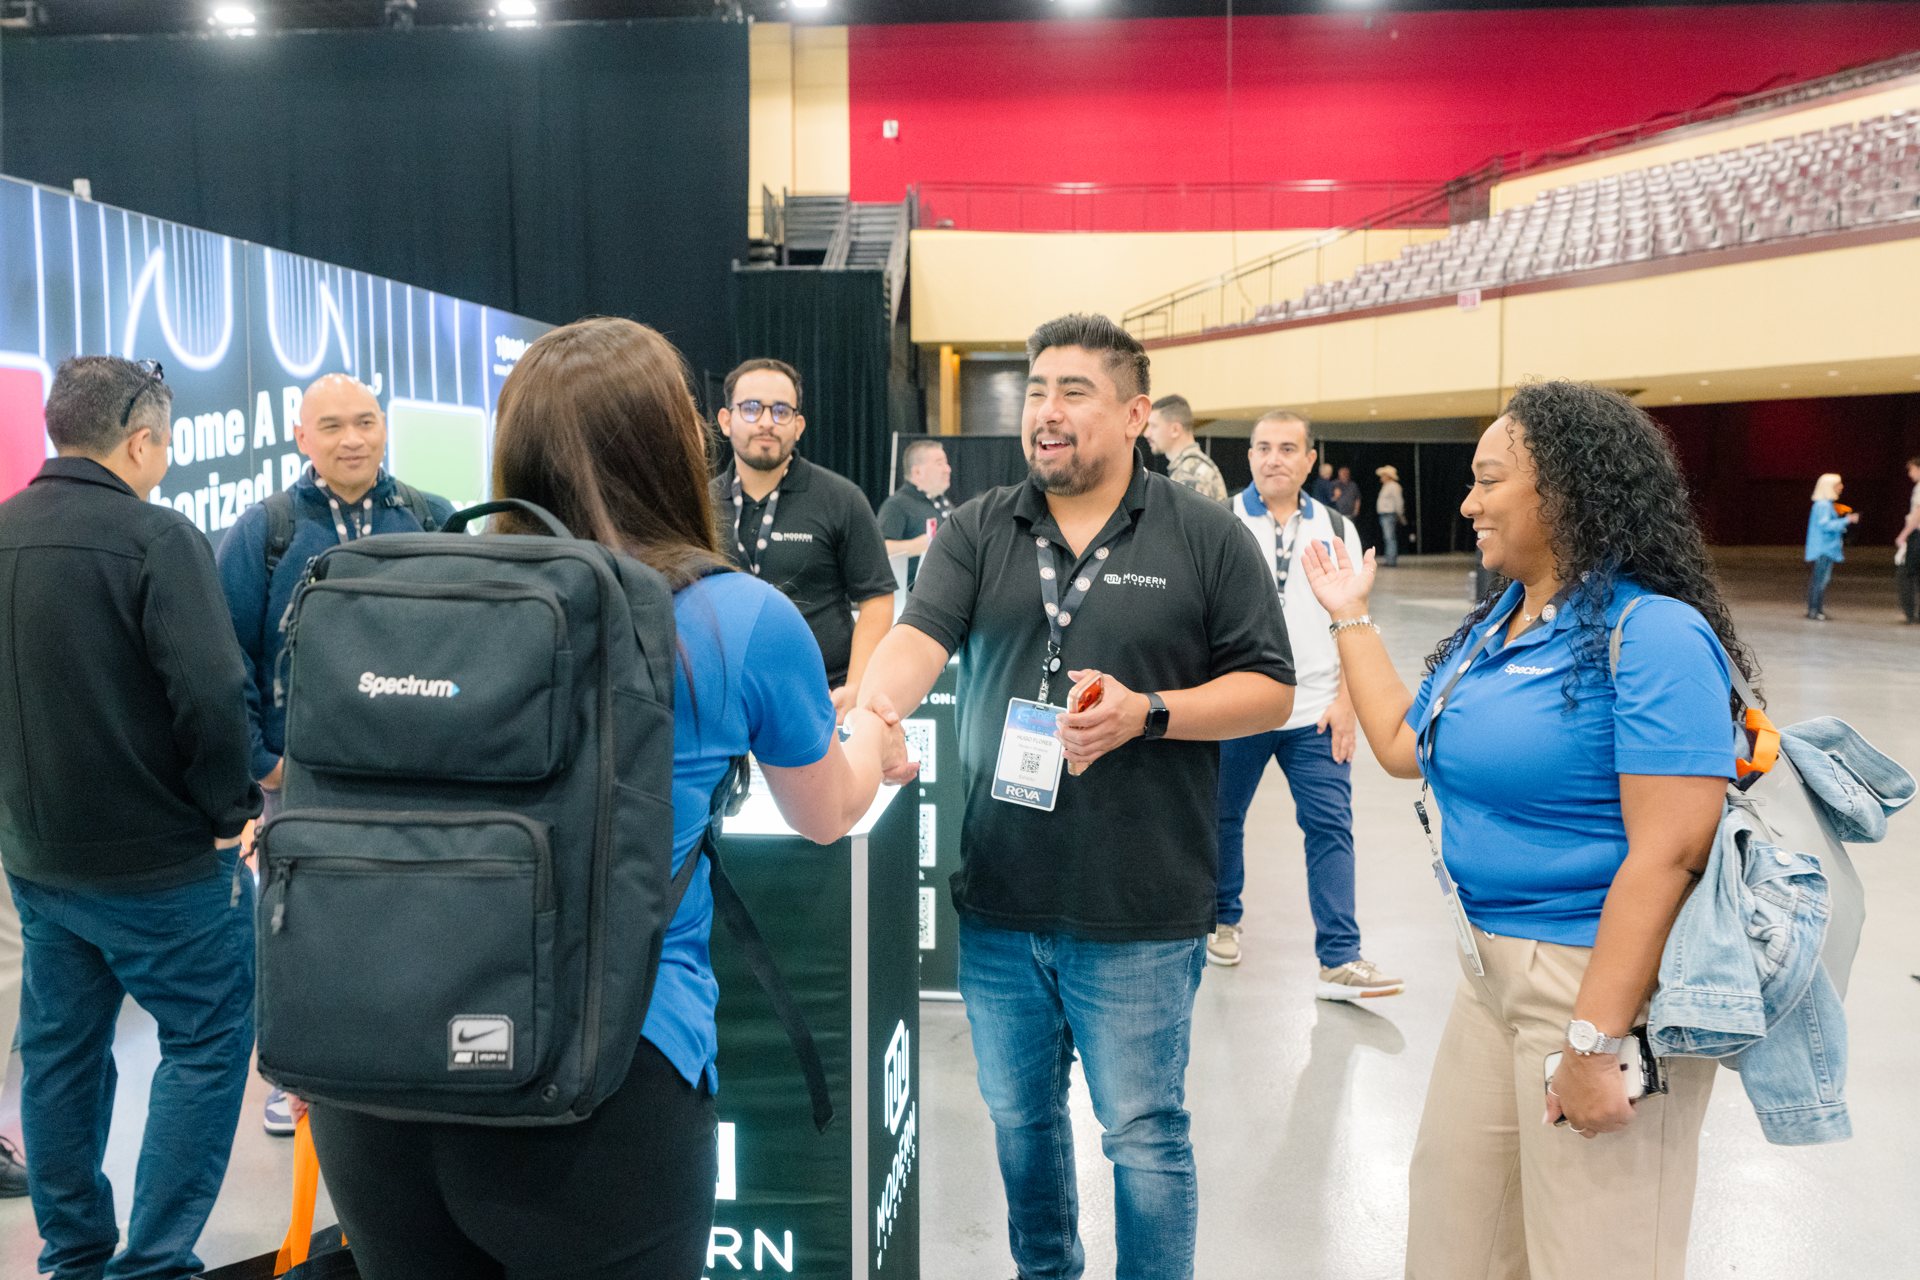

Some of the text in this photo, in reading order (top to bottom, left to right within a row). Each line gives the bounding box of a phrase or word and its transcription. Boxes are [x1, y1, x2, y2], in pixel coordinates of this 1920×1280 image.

[167, 409, 246, 467] ome
[253, 390, 276, 449] A
[1123, 572, 1167, 586] MODERN
[358, 671, 454, 699] Spectrum
[877, 1100, 916, 1247] MODERN
[706, 1226, 793, 1273] RN
